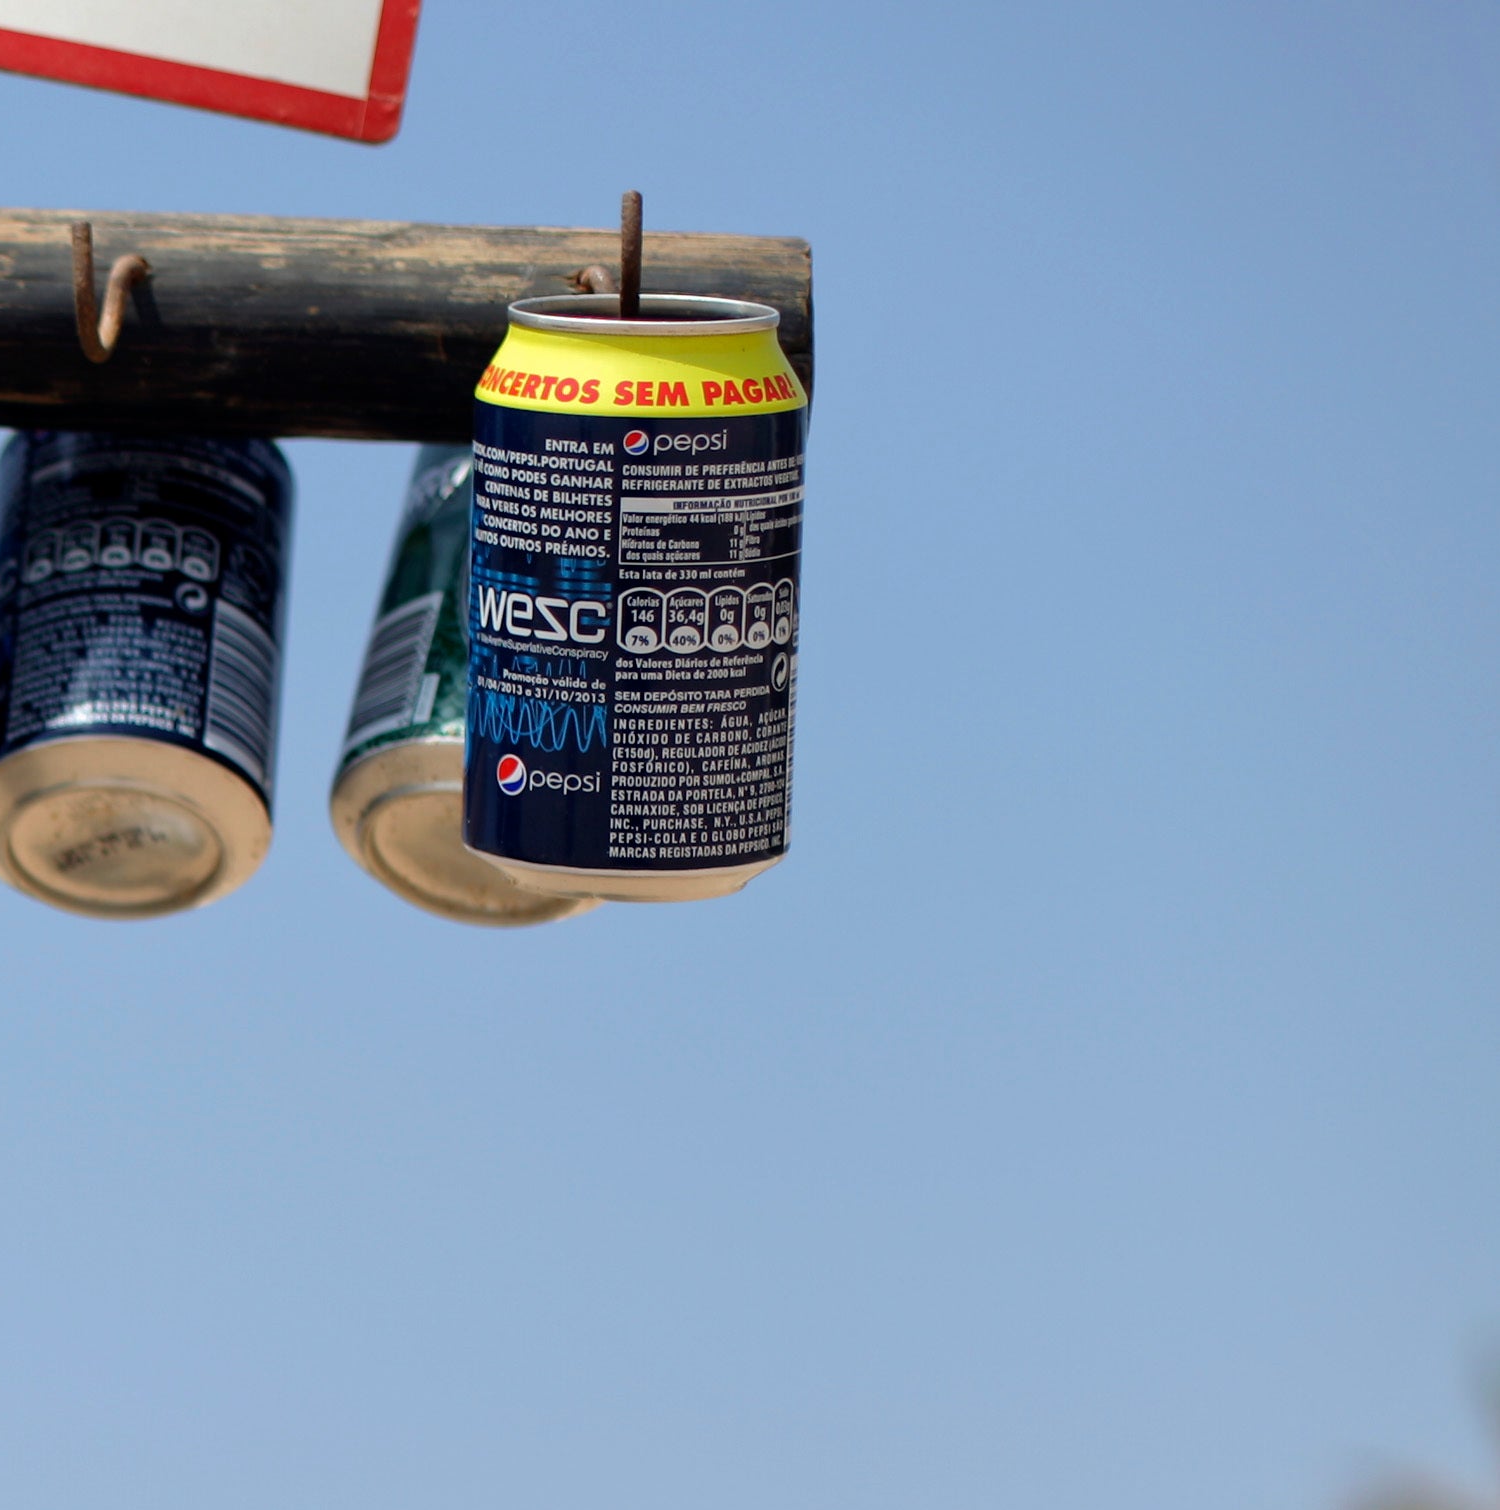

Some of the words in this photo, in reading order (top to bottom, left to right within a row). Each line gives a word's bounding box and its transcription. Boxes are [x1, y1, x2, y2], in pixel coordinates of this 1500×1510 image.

[480, 364, 601, 404] ONCERTOS
[612, 380, 690, 406] SEM
[701, 372, 797, 406] PAGAR!
[545, 439, 588, 454] ENTRA
[593, 442, 615, 455] EM
[653, 429, 728, 456] pepsi
[622, 464, 682, 477] CONSUMIR
[685, 464, 699, 476] DE
[702, 461, 765, 475] PREFERÊNCIA
[767, 457, 788, 472] ANTES
[484, 464, 509, 479] COMO
[511, 468, 547, 485] PODES
[550, 474, 613, 490] GANHAR
[622, 479, 704, 491] REFRIGERANTE
[707, 478, 721, 490] DE
[724, 474, 773, 490] EXTRACTOS
[484, 480, 531, 500] CENTENAS
[533, 489, 549, 502] DE
[552, 491, 612, 507] BILHETES
[491, 498, 520, 516] VERES
[521, 504, 537, 518] OS
[540, 507, 612, 524] MELHORES
[483, 514, 538, 535] CONCERTOS
[541, 524, 561, 538] DO
[564, 526, 599, 541] ANO
[604, 529, 611, 541] E
[500, 534, 541, 553] OUTROS
[545, 540, 610, 558] PRÉMIOS.
[619, 569, 640, 580] Esta
[642, 569, 663, 580] lata
[664, 569, 677, 580] de
[679, 569, 697, 580] 330
[699, 569, 712, 579] ml
[713, 568, 745, 579] contém
[626, 596, 660, 607] Calorias
[669, 596, 704, 610] Açúcares
[714, 595, 739, 607] Lípidos
[631, 609, 655, 623] 146
[668, 609, 705, 626] 36,4g
[719, 609, 735, 624] 0g
[754, 606, 767, 620] 0g
[631, 635, 650, 646] 7%
[672, 635, 697, 646] 40%
[718, 634, 736, 645] 0%
[752, 630, 766, 642] 0%
[615, 658, 633, 669] dos
[635, 658, 673, 669] Valores
[674, 657, 708, 668] Diários
[709, 657, 721, 668] de
[722, 654, 764, 667] Referência
[503, 668, 549, 686] Promoção
[552, 675, 587, 690] válida
[591, 679, 606, 690] de
[534, 688, 606, 704] 31/10/2013
[614, 691, 641, 702] SEM
[643, 689, 703, 701] DEPÓSITO
[704, 689, 732, 700] TARA
[734, 685, 770, 699] PERDIDA
[614, 703, 678, 714] CONSUMIR
[680, 703, 705, 714] BEM
[707, 700, 747, 713] FRESCO
[613, 718, 713, 731] INGREDIENTES:
[613, 731, 669, 745] DIÓXIDO
[675, 732, 691, 744] DE
[696, 729, 753, 745] CARBONO,
[529, 771, 601, 794] pepsi
